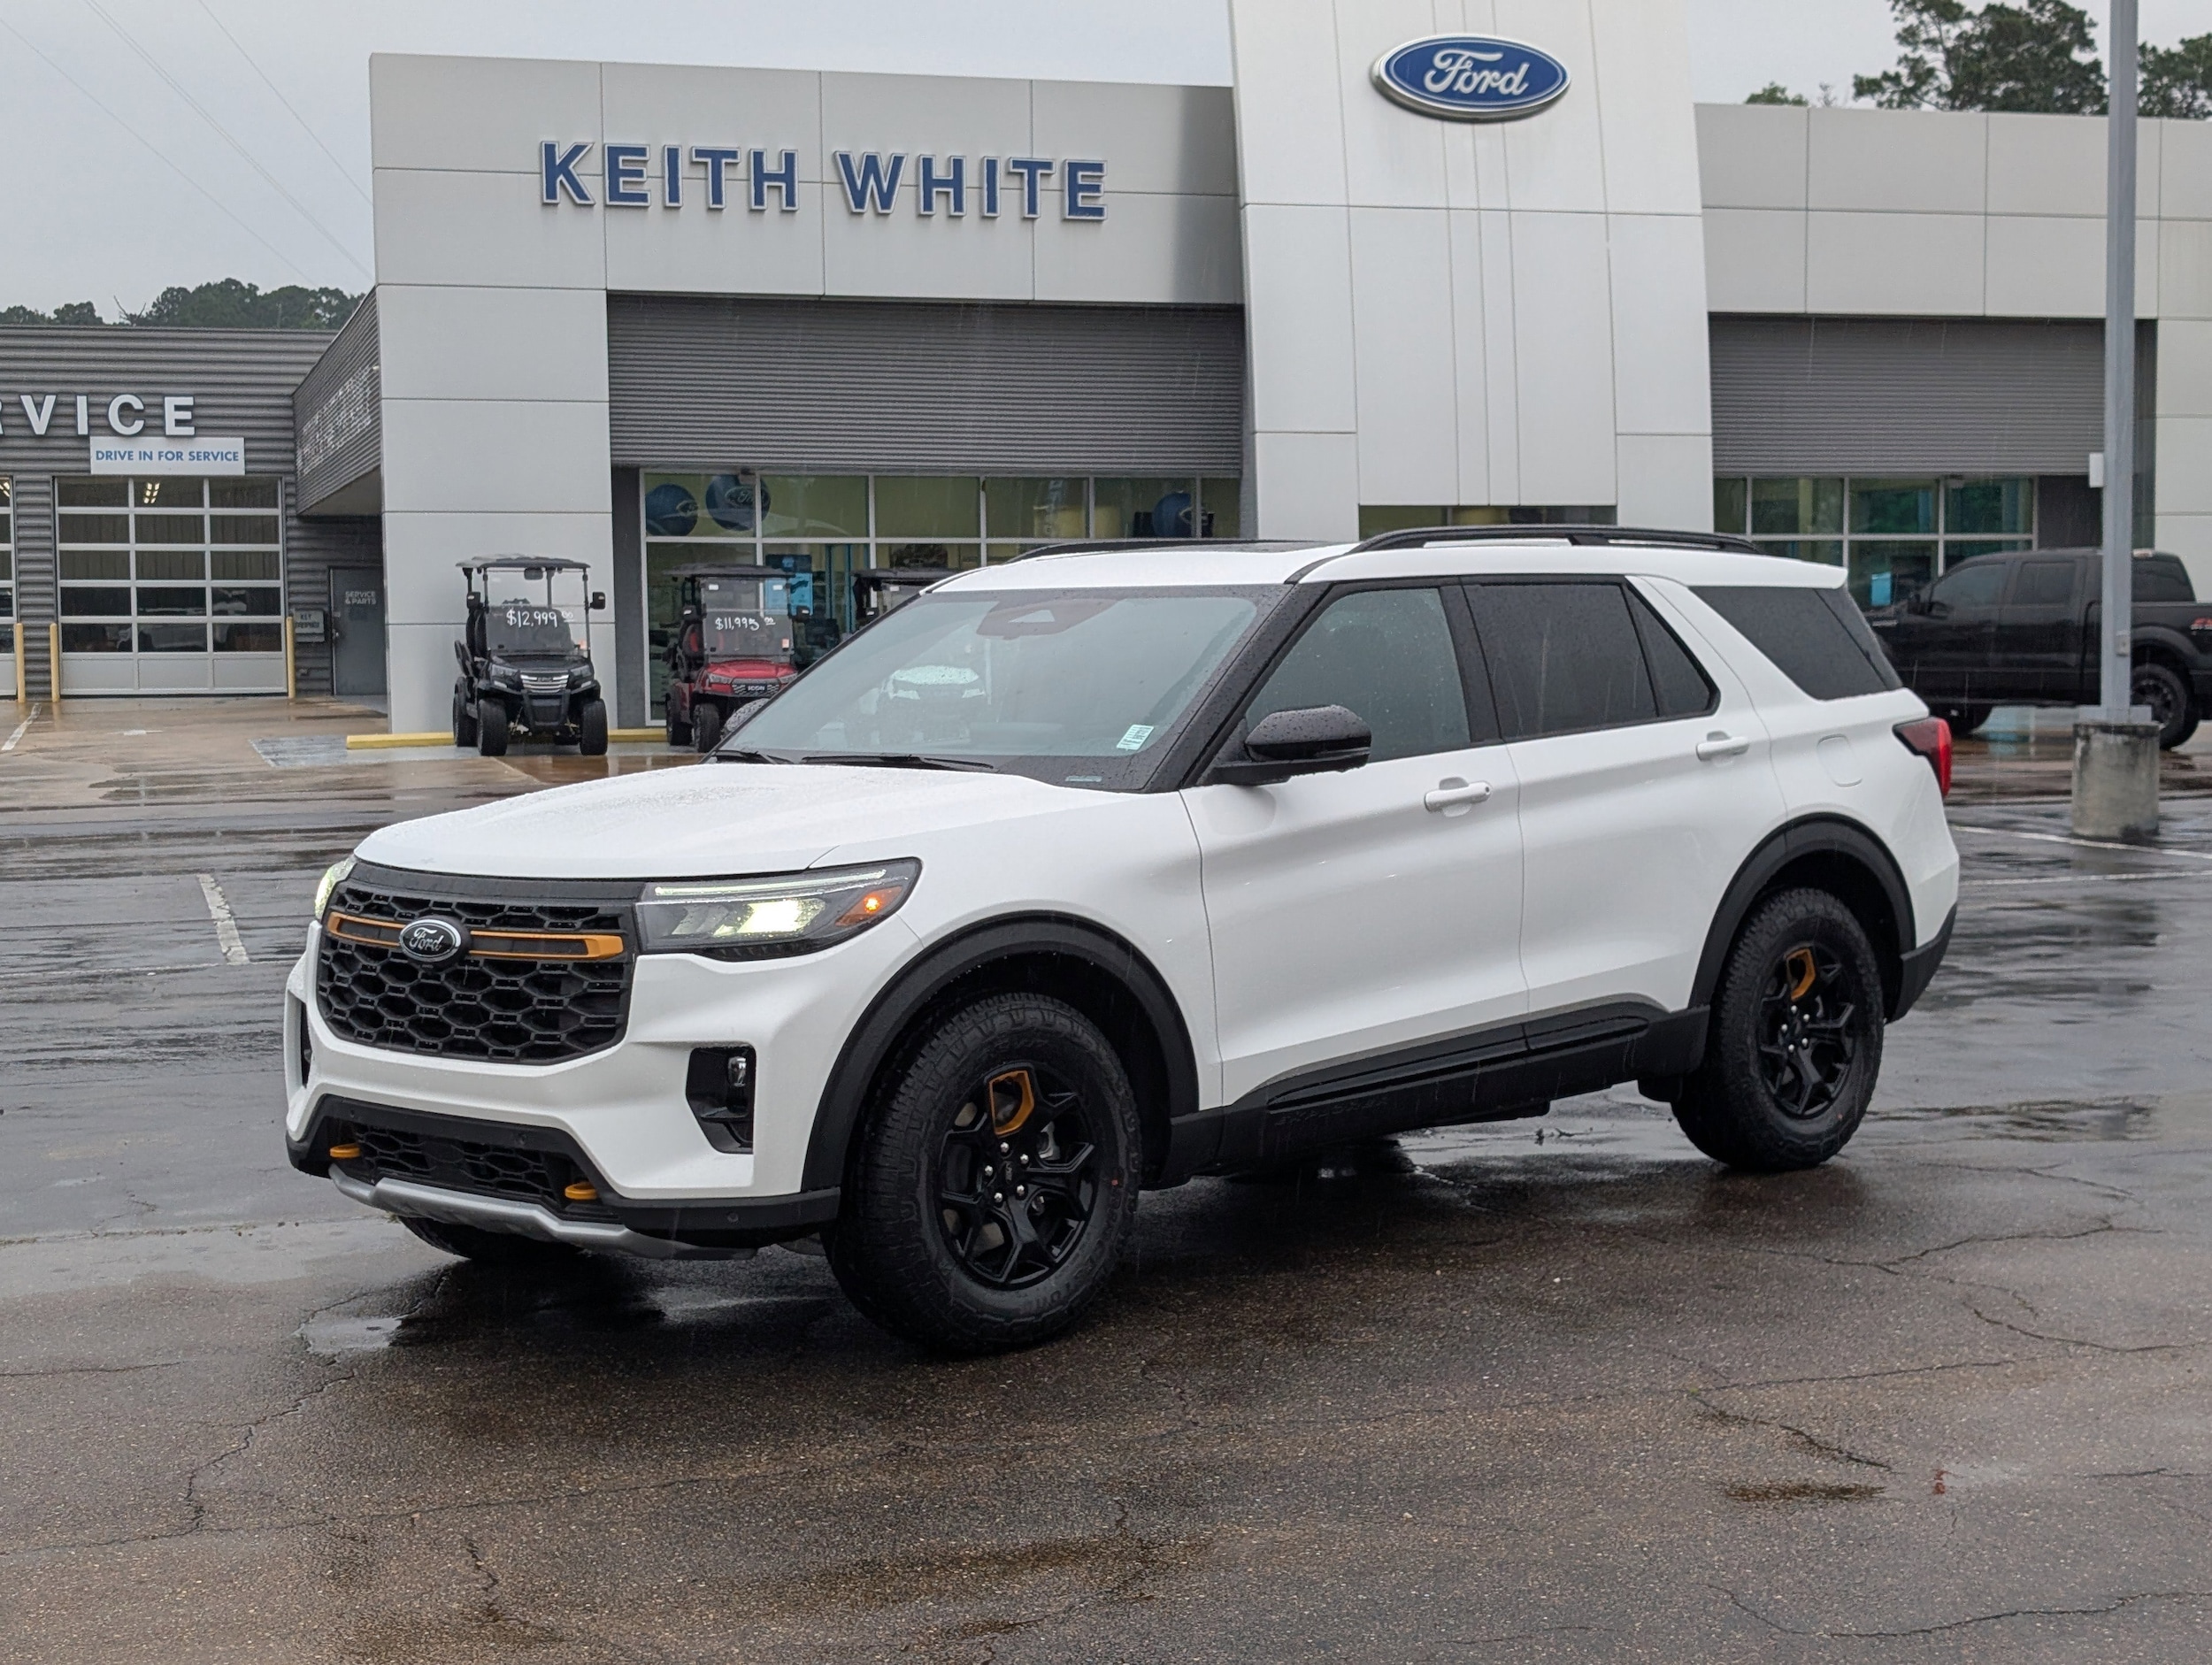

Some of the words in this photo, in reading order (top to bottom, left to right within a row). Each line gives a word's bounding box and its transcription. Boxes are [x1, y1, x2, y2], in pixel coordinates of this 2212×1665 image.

[1424, 49, 1530, 96] Ford
[541, 141, 798, 211] KEITH
[834, 150, 1108, 220] WHITE
[0, 394, 196, 436] VICE
[96, 450, 134, 461] DRIVE
[139, 450, 153, 461] IN
[158, 450, 184, 461] FOR
[188, 450, 239, 462] SERVICE
[506, 608, 557, 628] $12,999
[715, 617, 759, 631] $11,995
[409, 926, 444, 952] Ford
